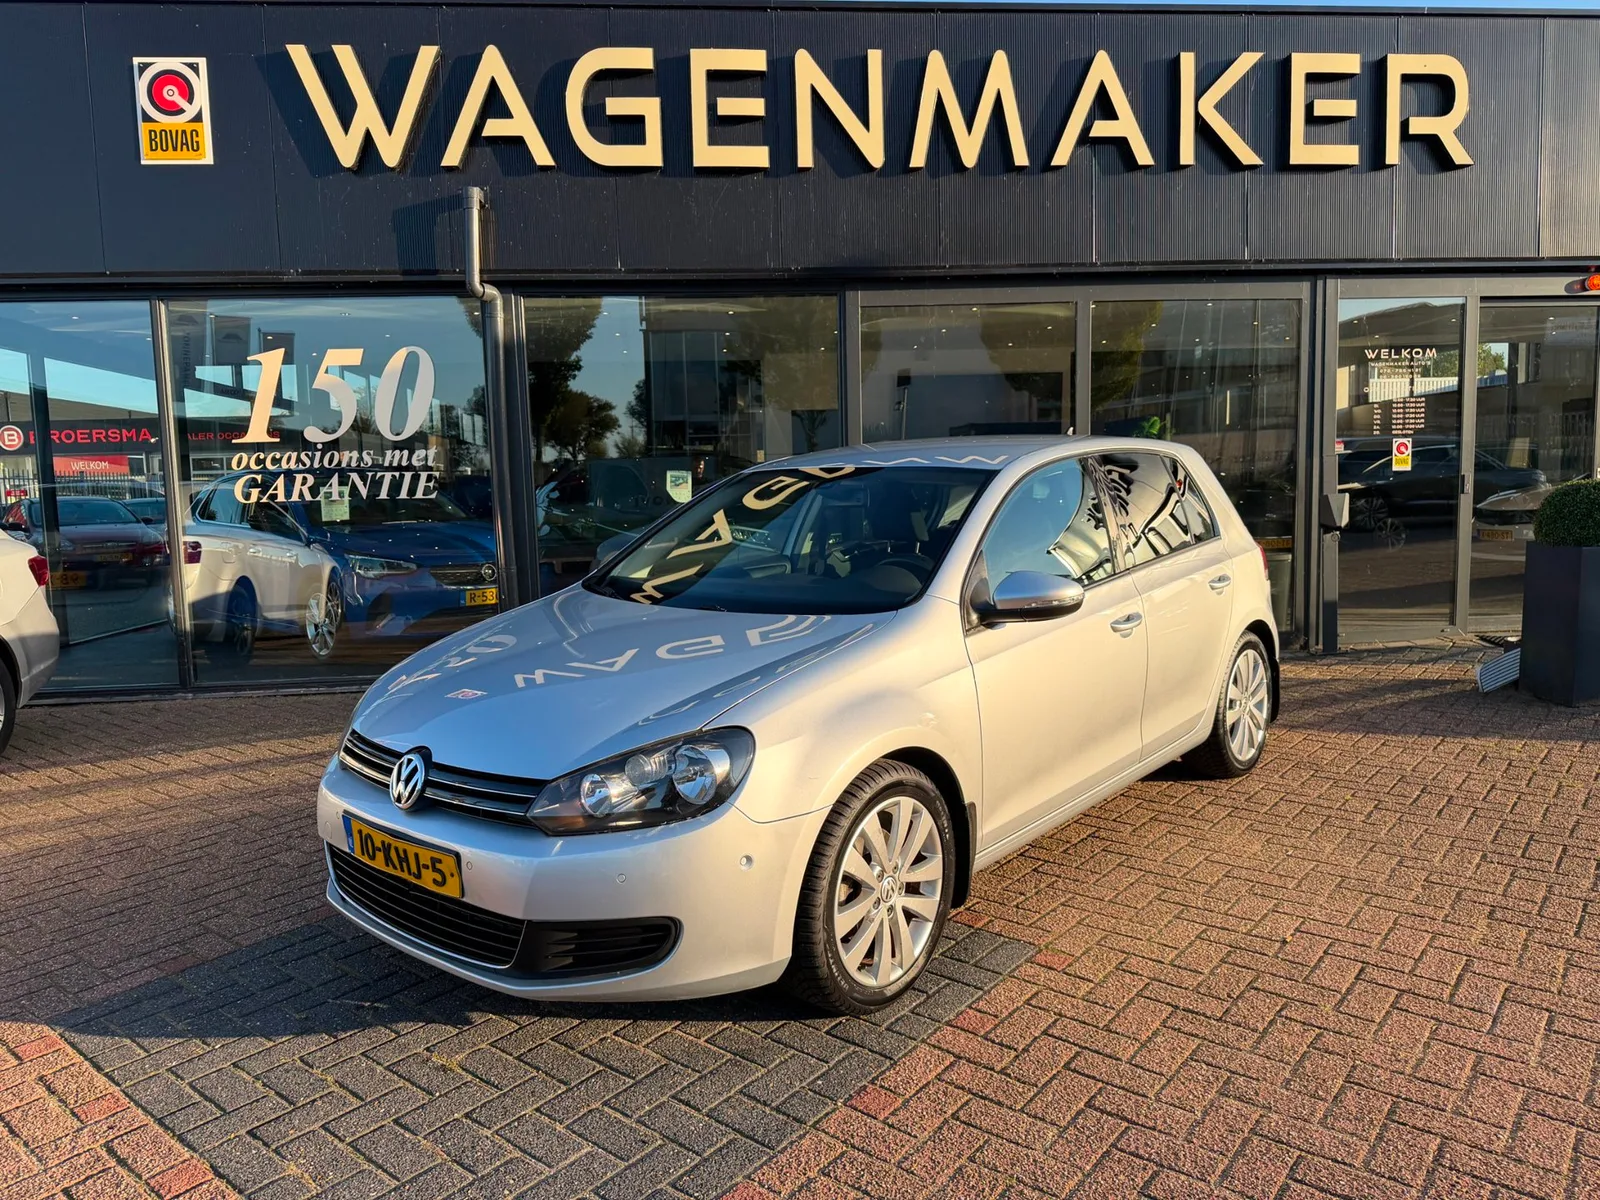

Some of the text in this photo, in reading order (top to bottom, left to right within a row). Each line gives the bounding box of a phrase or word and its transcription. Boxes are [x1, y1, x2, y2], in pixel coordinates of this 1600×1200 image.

[286, 43, 1474, 168] WAGENMAKER
[148, 129, 200, 152] BOVAG
[1364, 348, 1437, 359] WELKOM
[231, 346, 435, 443] 150
[70, 461, 109, 470] WELKOM
[231, 443, 438, 470] occasions met
[233, 471, 440, 504] GARANTIE
[469, 590, 498, 603] R-53
[357, 828, 447, 887] 10-KHJ-5
